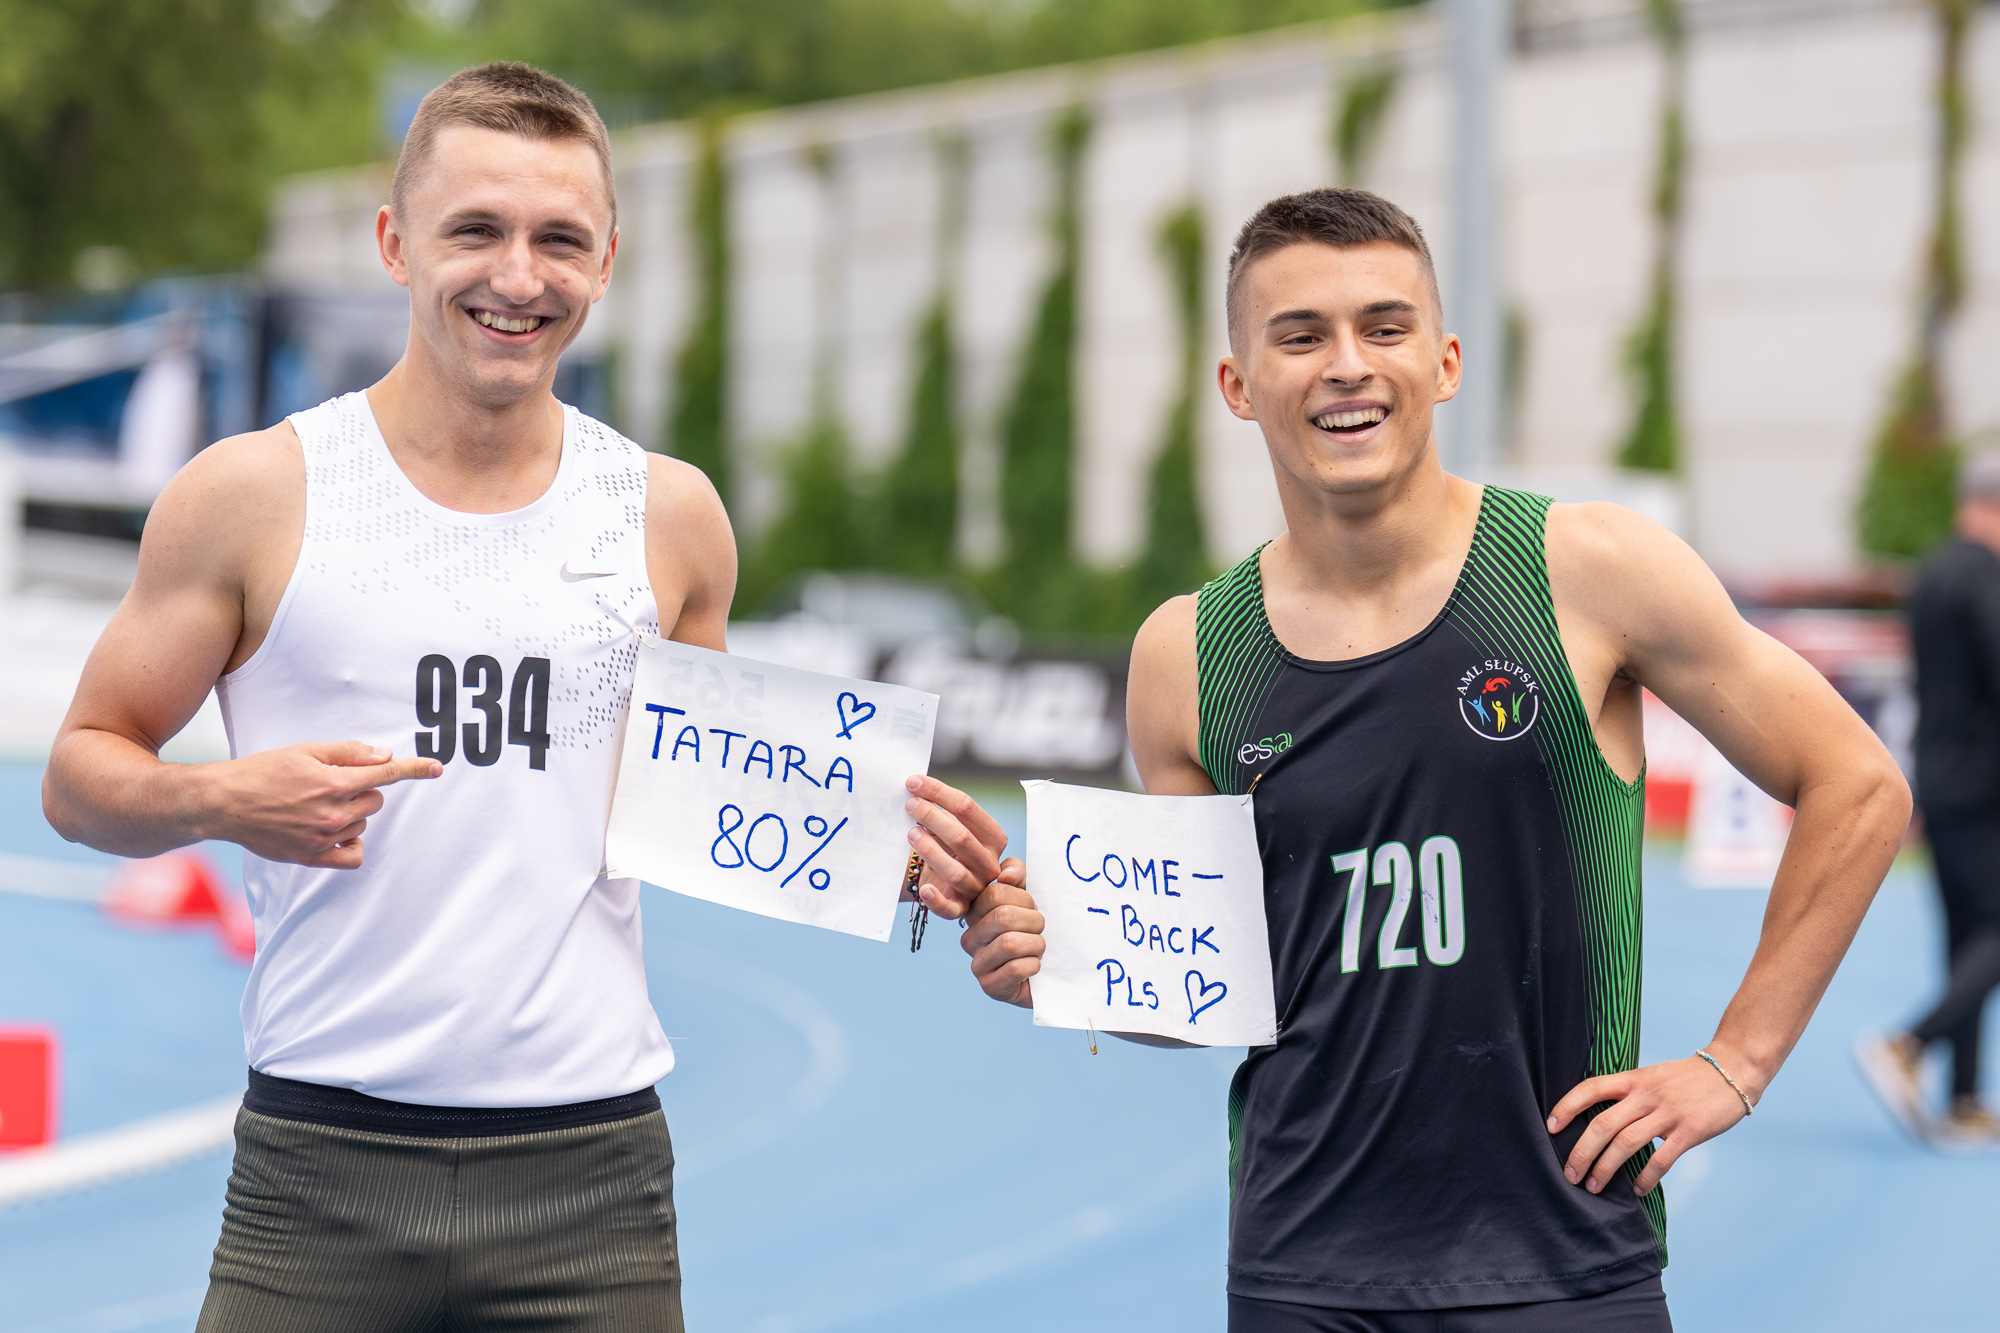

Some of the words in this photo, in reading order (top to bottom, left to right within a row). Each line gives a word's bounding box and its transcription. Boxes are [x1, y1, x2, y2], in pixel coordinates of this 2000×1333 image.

[415, 654, 550, 771] 934
[1456, 665, 1483, 696] AML
[1484, 659, 1540, 693] SŁUPSK
[645, 703, 853, 792] TATARA
[1237, 732, 1293, 765] esa
[711, 804, 848, 890] 80%
[1330, 835, 1465, 974] 720
